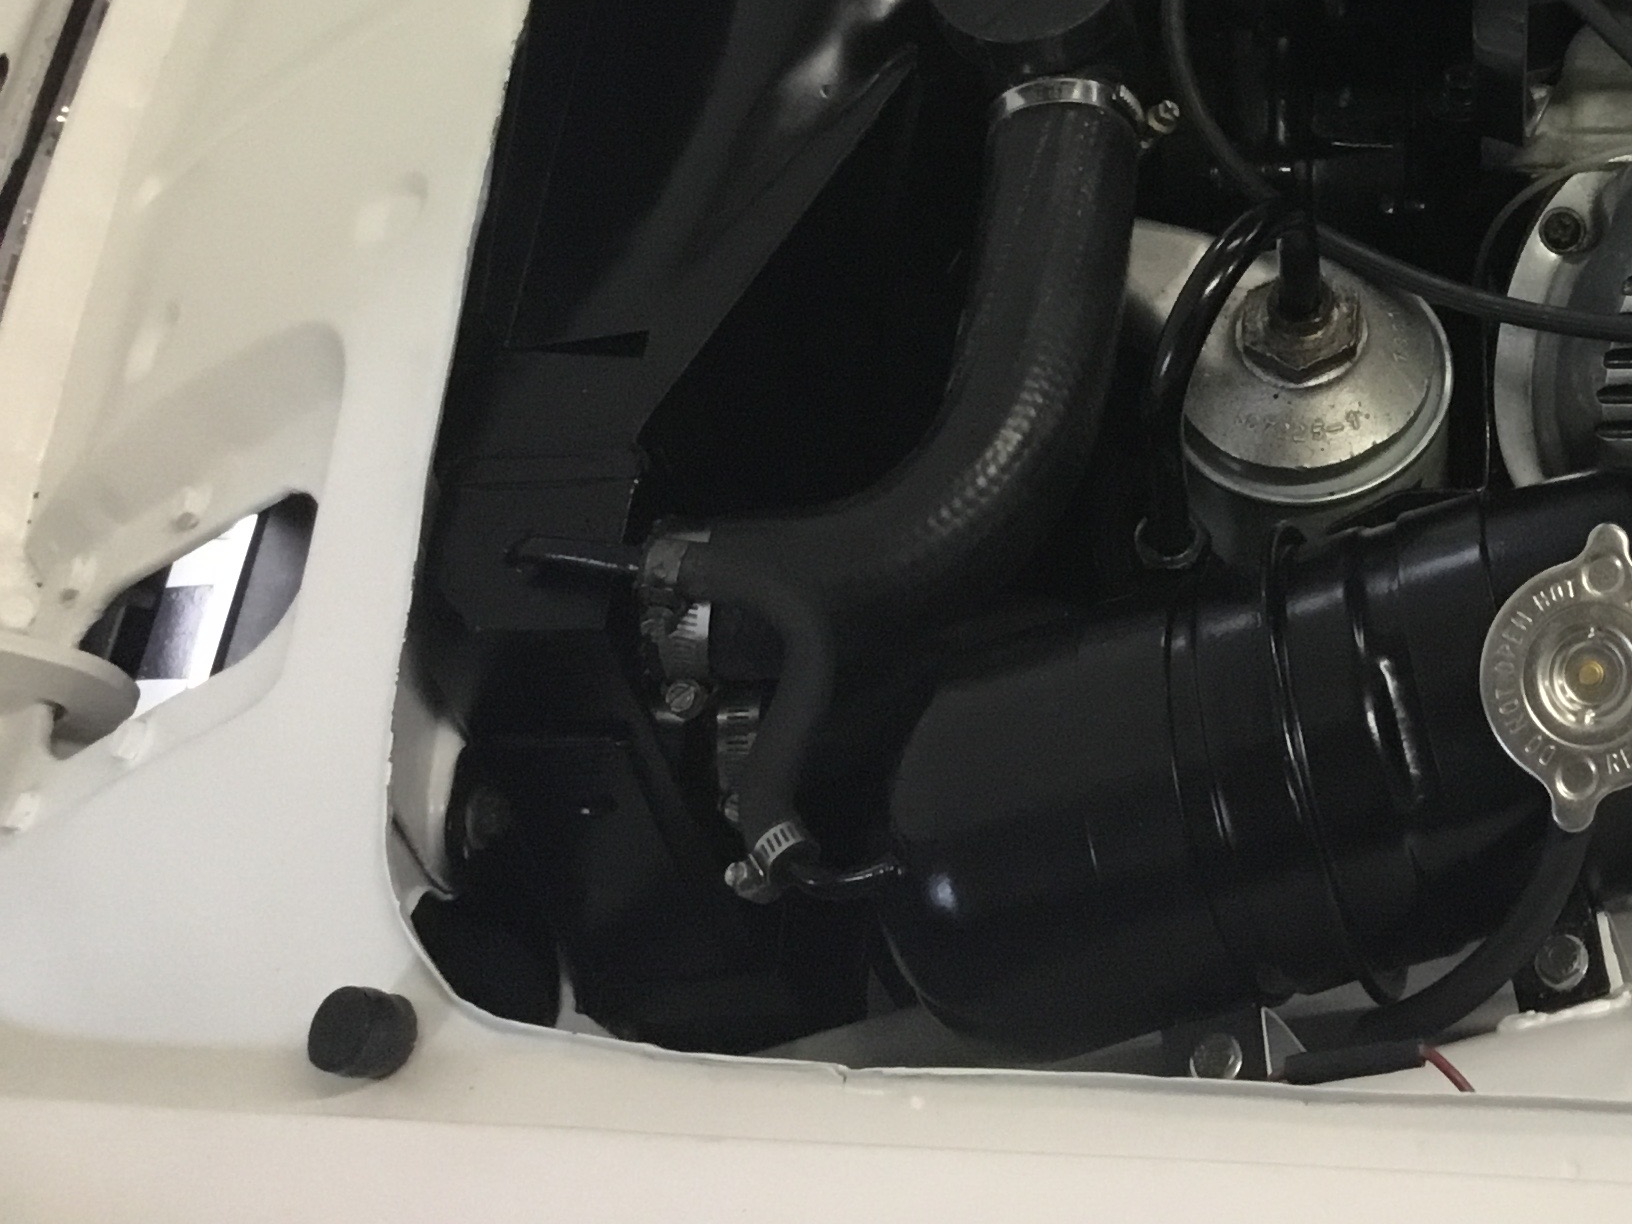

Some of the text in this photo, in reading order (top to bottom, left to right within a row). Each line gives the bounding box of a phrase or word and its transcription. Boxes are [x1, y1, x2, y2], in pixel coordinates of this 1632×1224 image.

[1532, 579, 1575, 612] HOT
[1494, 610, 1533, 674] OPEN
[1524, 734, 1556, 767] DO
